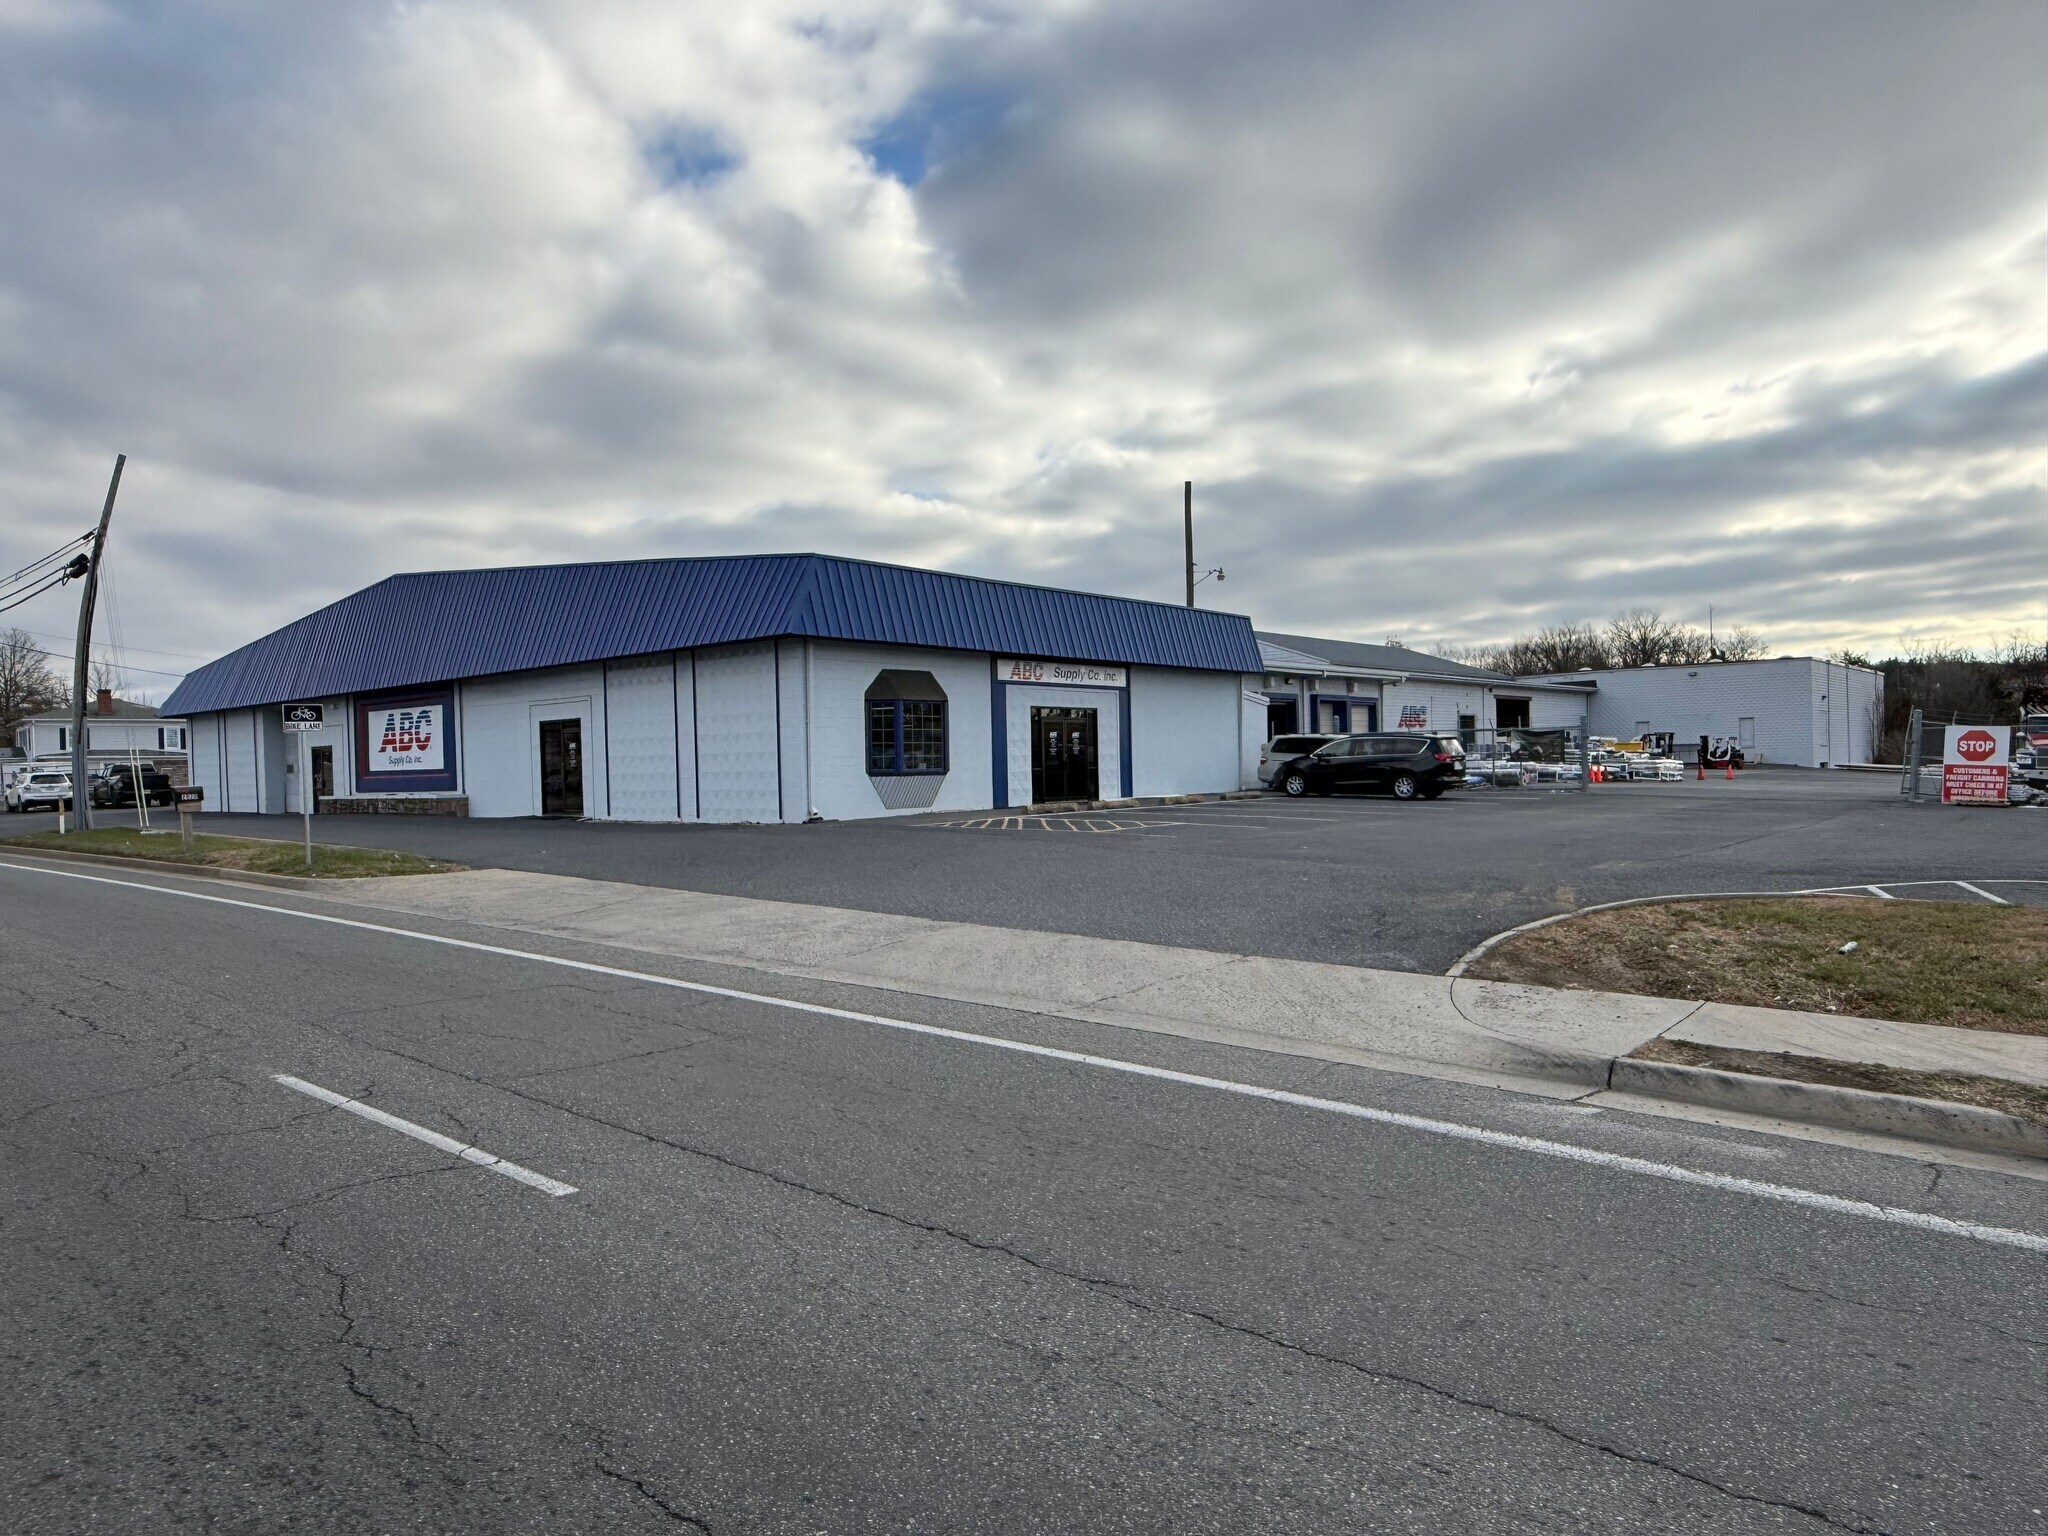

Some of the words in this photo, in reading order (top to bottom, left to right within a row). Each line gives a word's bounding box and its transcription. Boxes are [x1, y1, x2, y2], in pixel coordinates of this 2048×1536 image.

[1010, 661, 1043, 681] ABC
[1053, 666, 1086, 682] Supply
[1087, 669, 1101, 681] Co.
[1397, 705, 1427, 728] ABC
[285, 722, 302, 730] BIKE
[304, 722, 322, 730] LANE
[378, 710, 432, 753] ABC
[1959, 740, 1994, 752] STOP
[389, 755, 404, 767] Supply
[1952, 767, 1991, 775] CUSTOMERS
